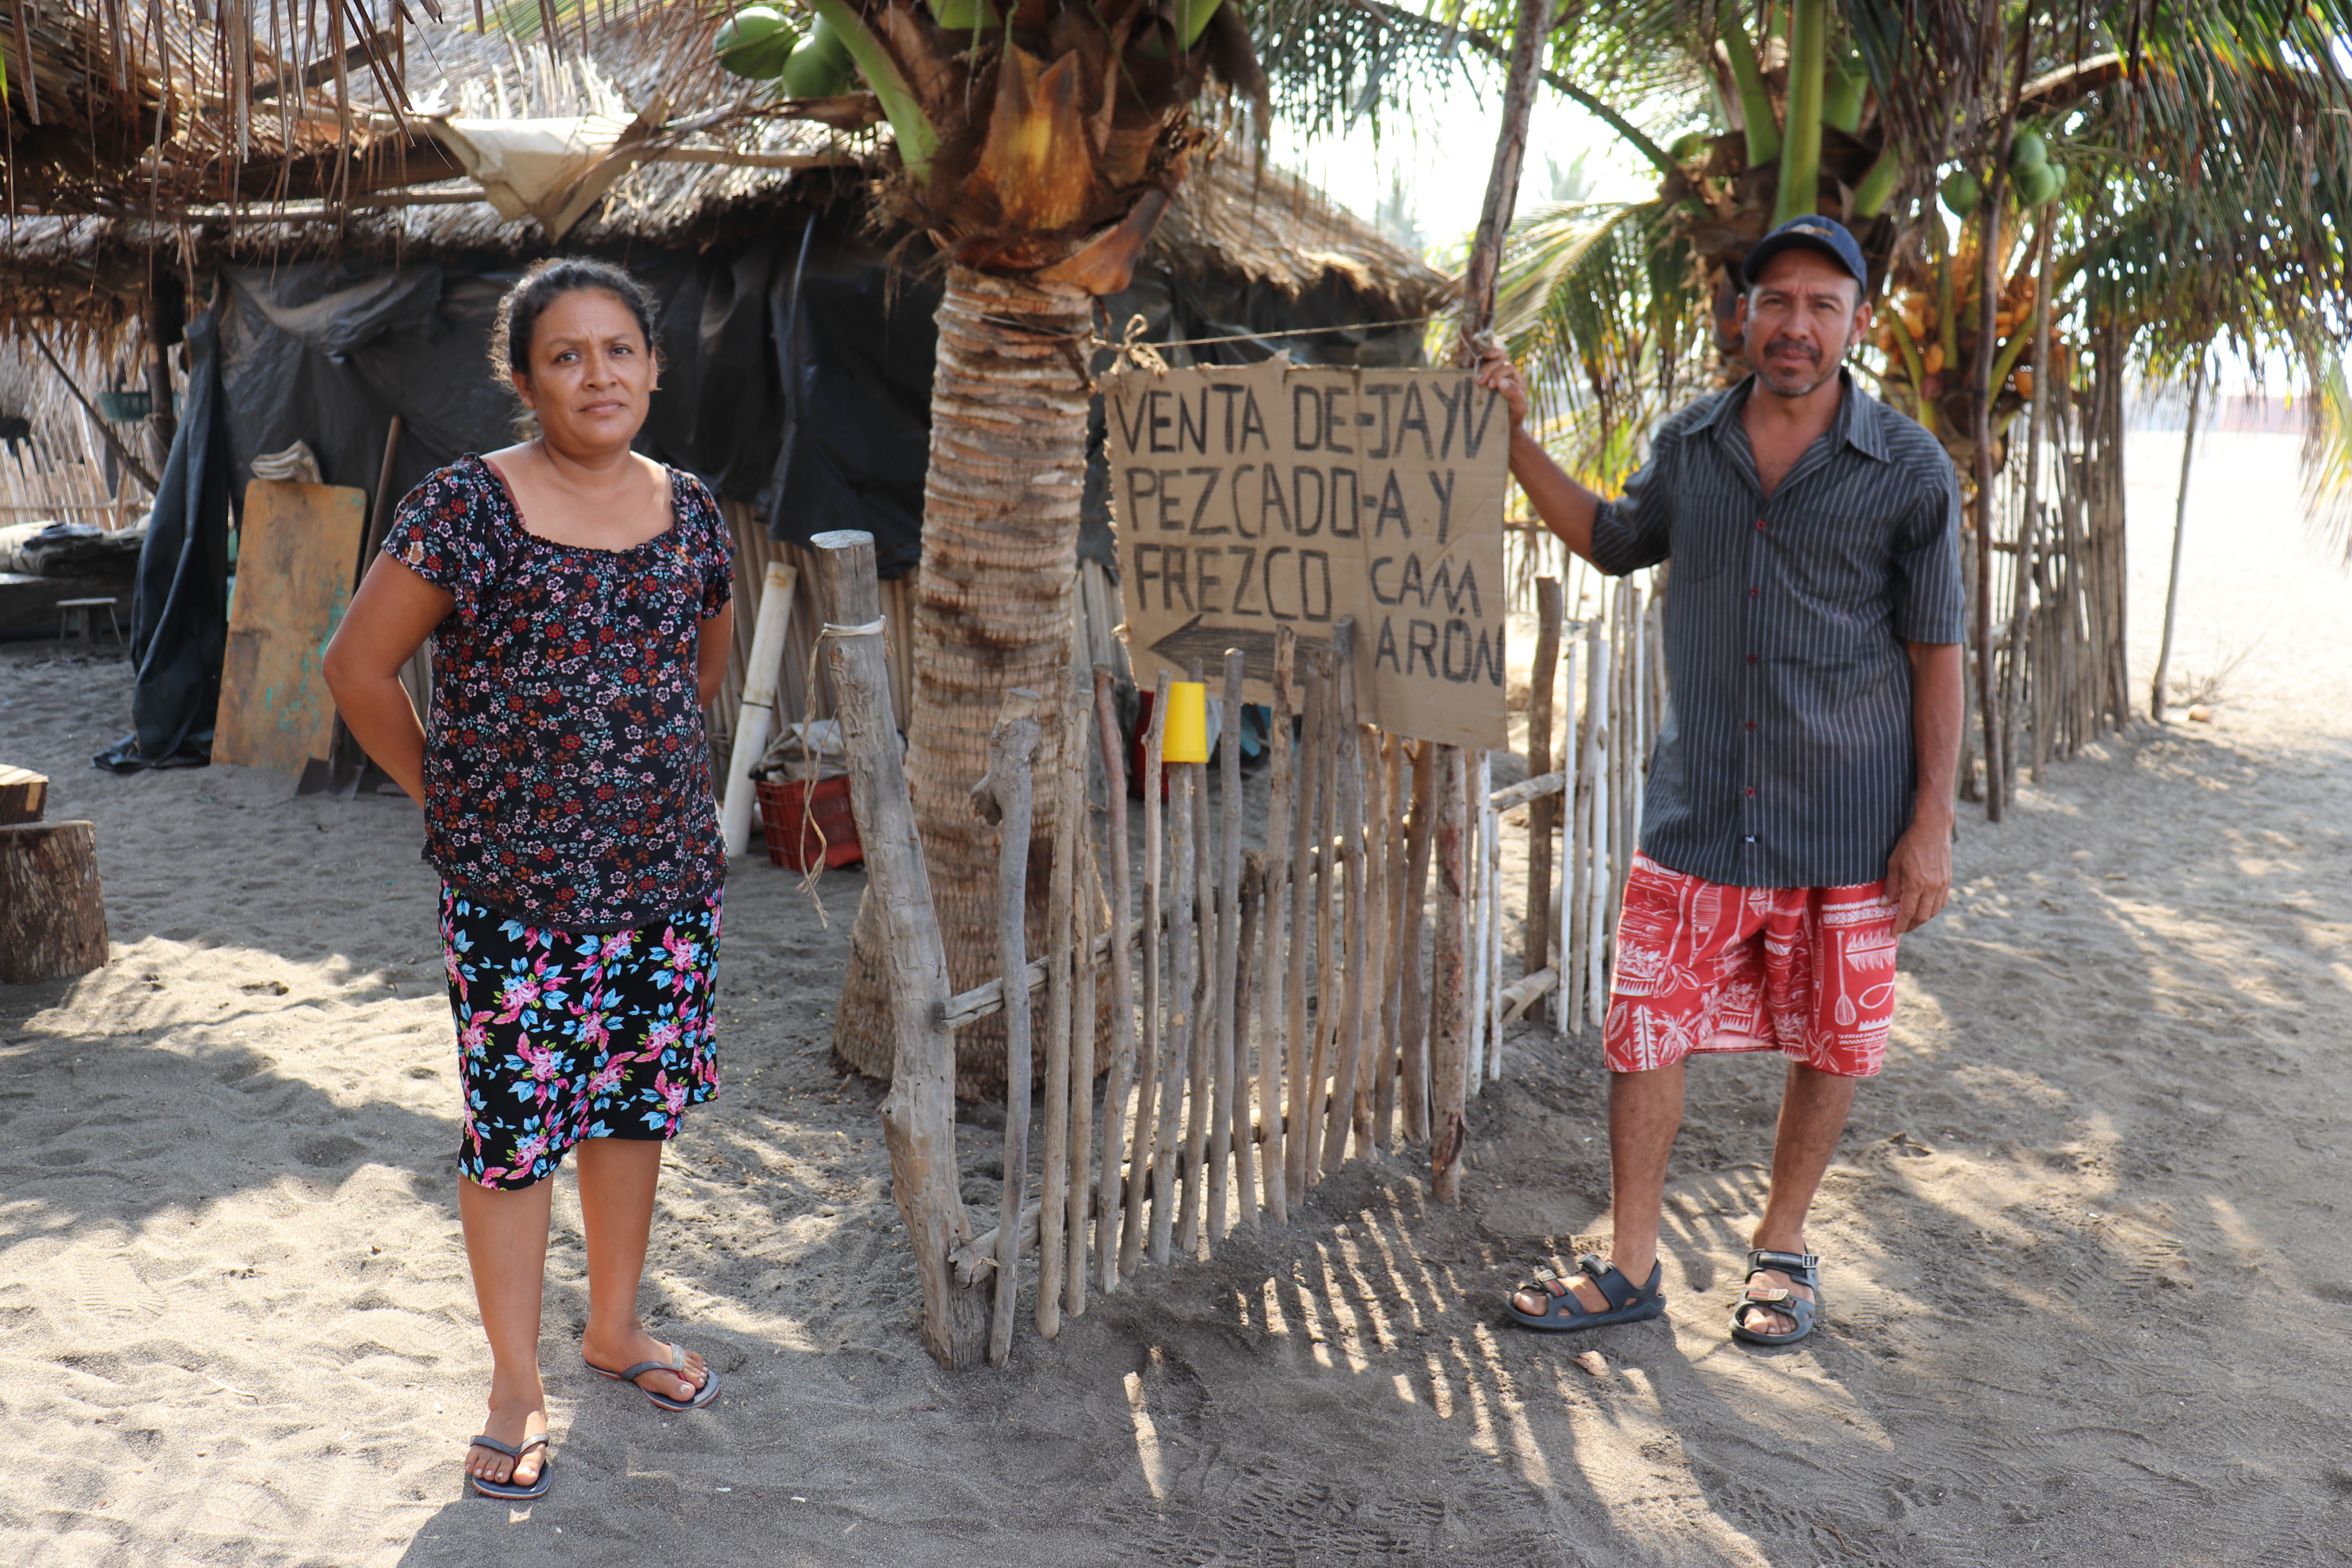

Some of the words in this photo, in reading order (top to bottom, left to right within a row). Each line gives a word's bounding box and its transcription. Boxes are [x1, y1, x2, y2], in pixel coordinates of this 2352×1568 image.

[1114, 383, 1270, 455] VENTA
[1428, 468, 1455, 545] Y
[1134, 543, 1333, 623] FREZCO
[1370, 551, 1482, 618] CAM
